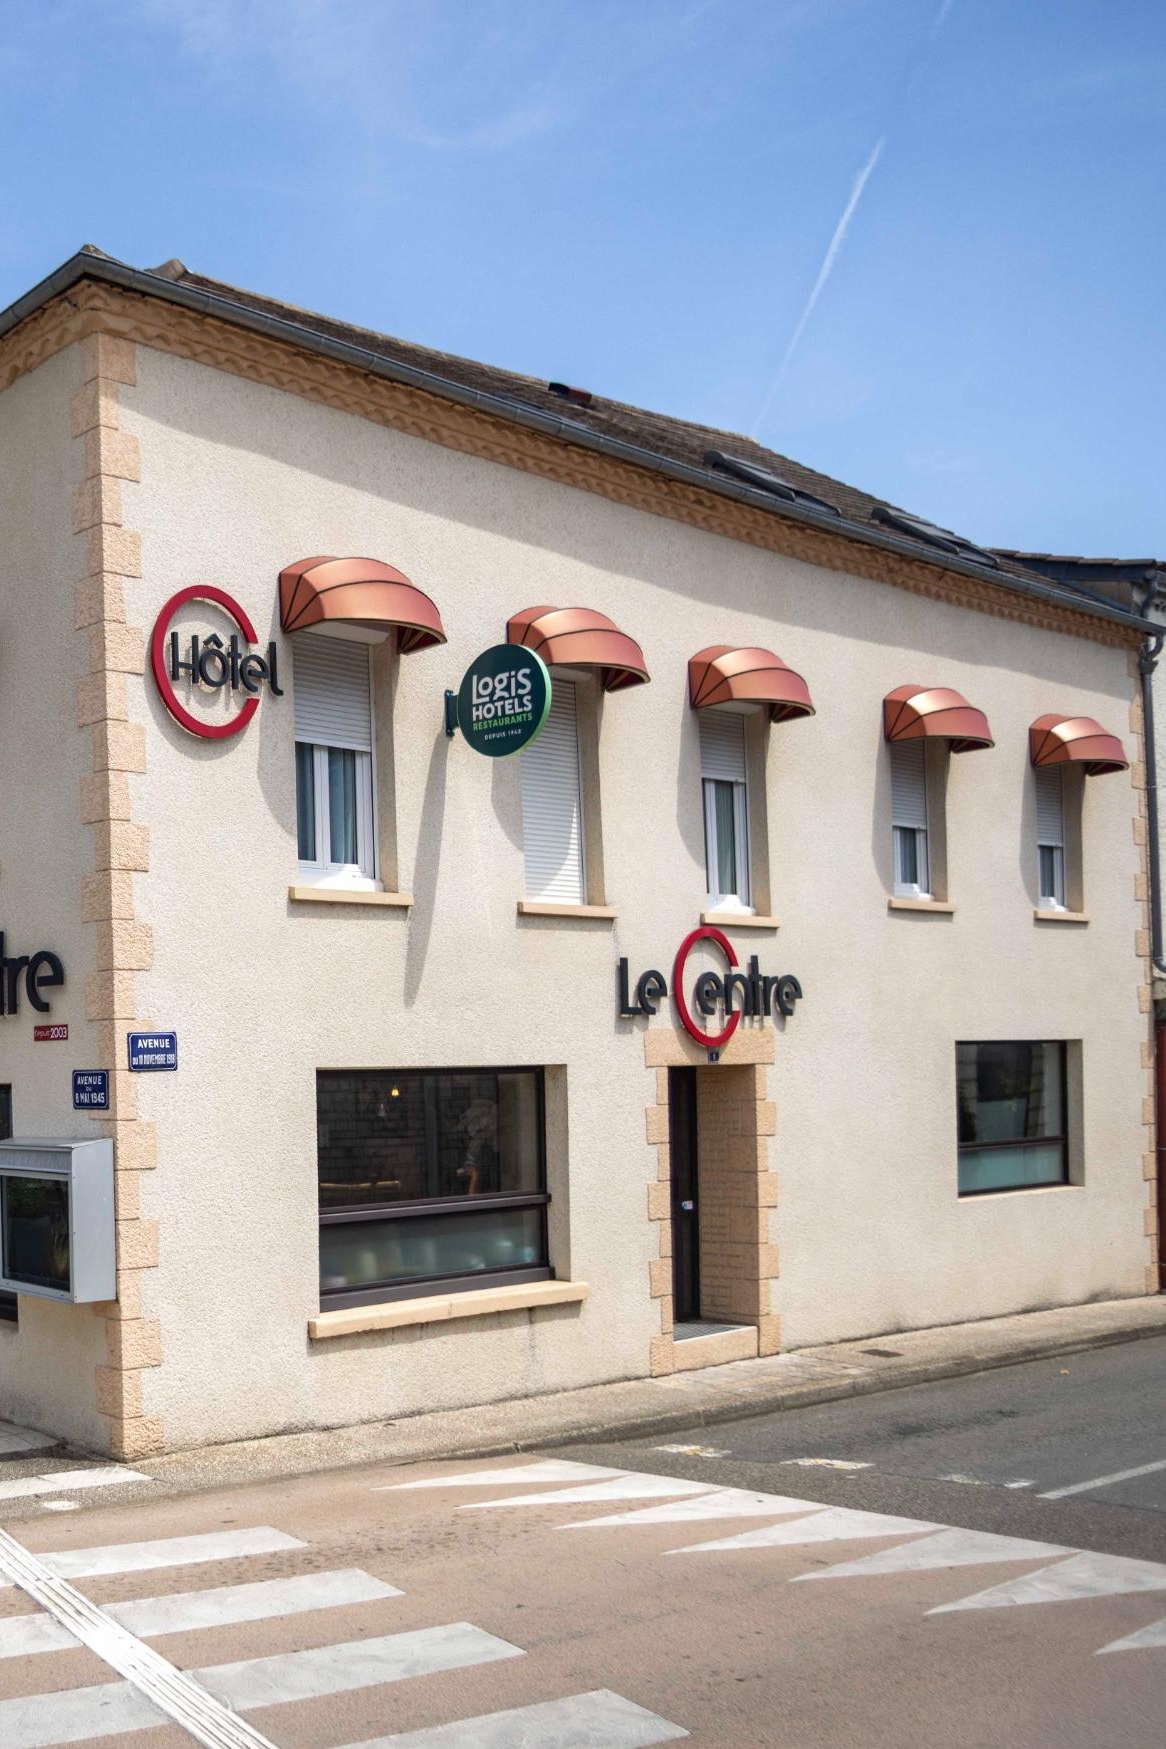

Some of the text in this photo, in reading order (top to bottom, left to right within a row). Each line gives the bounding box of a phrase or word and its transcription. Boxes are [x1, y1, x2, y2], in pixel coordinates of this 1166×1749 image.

[170, 631, 284, 697] Hôtel
[473, 712, 533, 731] RESTAURANTS
[484, 730, 506, 740] DEPUIS
[619, 926, 803, 1047] Le Centre
[50, 1026, 67, 1039] 2003
[137, 1038, 170, 1049] AVENUE
[77, 1075, 102, 1085] AVENUE
[75, 1092, 105, 1104] 8 MAI 1945
